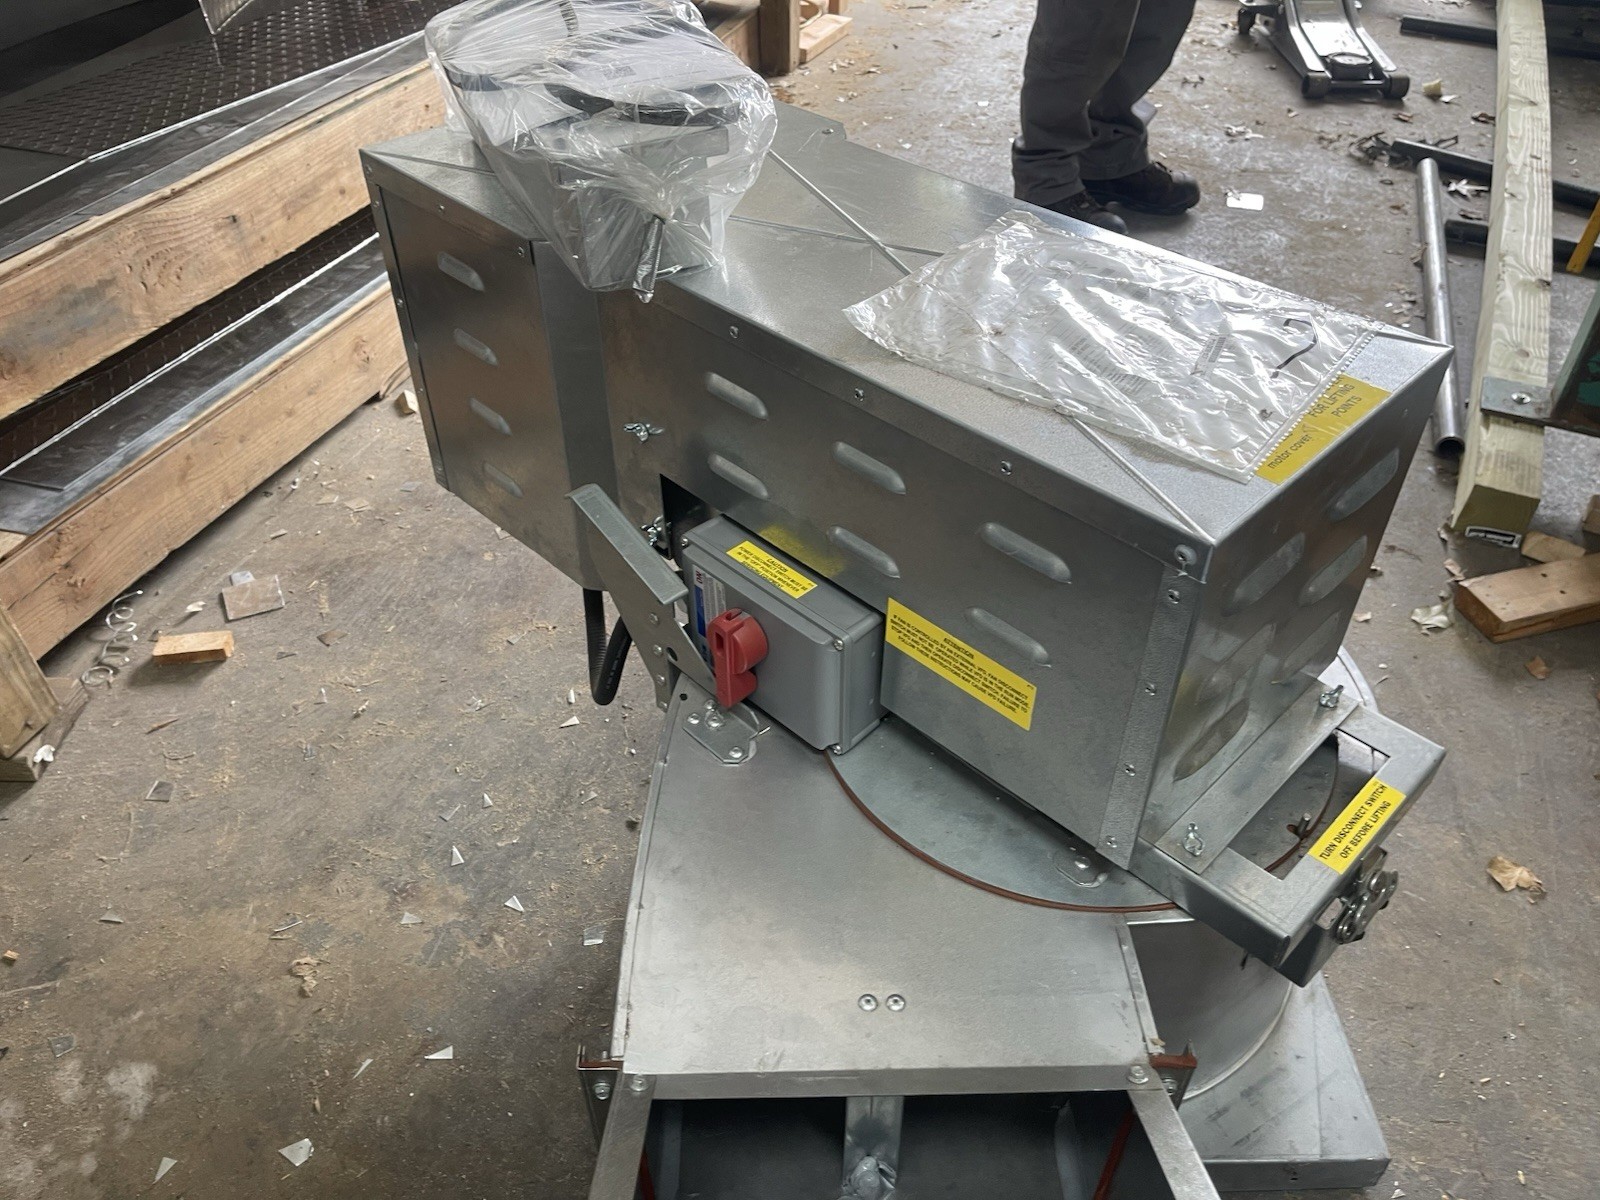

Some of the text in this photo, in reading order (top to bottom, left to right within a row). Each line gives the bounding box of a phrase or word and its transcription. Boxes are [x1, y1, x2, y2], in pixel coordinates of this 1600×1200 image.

[1308, 402, 1329, 419] FOR
[1326, 383, 1355, 406] LIFTING
[1331, 393, 1363, 419] POINTS
[1267, 449, 1292, 470] motor
[738, 546, 754, 556] POWER
[752, 555, 777, 571] DISCONNECT
[775, 570, 791, 580] SWITCH
[790, 579, 802, 587] MUST
[759, 566, 778, 578] POSITION
[776, 577, 800, 592] WHENEVER
[766, 558, 789, 573] CAUTION
[891, 618, 906, 631] SWITCH
[907, 628, 918, 639] MUST
[919, 636, 928, 645] NOT
[935, 646, 958, 664] OPERATED
[959, 661, 973, 673] WHILE
[994, 683, 1003, 692] THE
[1004, 689, 1014, 699] RUN
[891, 625, 902, 635] STOP
[911, 637, 920, 646] AND
[921, 643, 932, 654] THEN
[933, 651, 952, 666] OPERATE
[953, 663, 981, 684] DISCONNECT
[1000, 693, 1020, 708] FAILURE
[898, 616, 906, 625] FAN
[911, 625, 939, 646] CONTROLLED
[954, 651, 976, 669] EXTERNAL
[988, 672, 997, 682] FAN
[998, 678, 1028, 701] DISCONNECT
[898, 635, 915, 650] FOLLOW
[916, 647, 929, 658] THESE
[930, 655, 961, 678] INSTRUCTIONS
[961, 675, 971, 684] MAY
[971, 681, 986, 694] CAUSE
[1319, 784, 1387, 860] TURN DISCONNECT SWITCH
[1339, 800, 1392, 859] OFF BEFORE LIFTING
